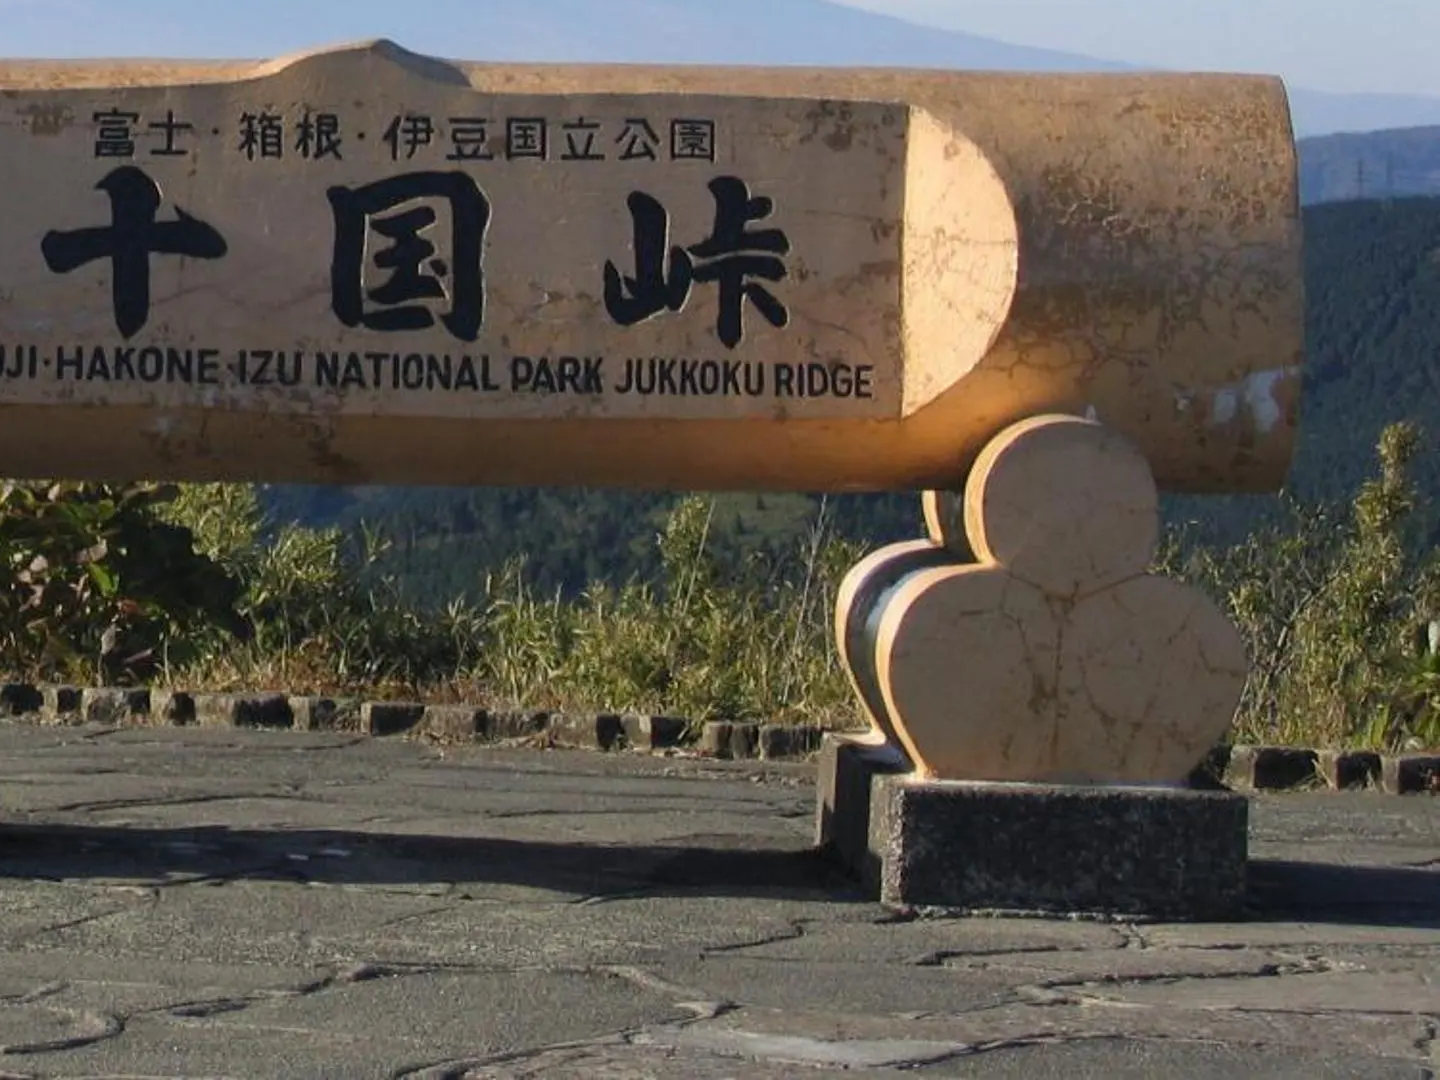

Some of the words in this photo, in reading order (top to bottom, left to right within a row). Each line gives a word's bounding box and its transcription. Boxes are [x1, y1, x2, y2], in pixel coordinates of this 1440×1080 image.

[40, 165, 792, 350] 十国峠
[315, 351, 500, 393] NATIONAL
[510, 356, 603, 395] PARK
[614, 359, 763, 397] JUKKOKU
[773, 362, 875, 400] RIDGE
